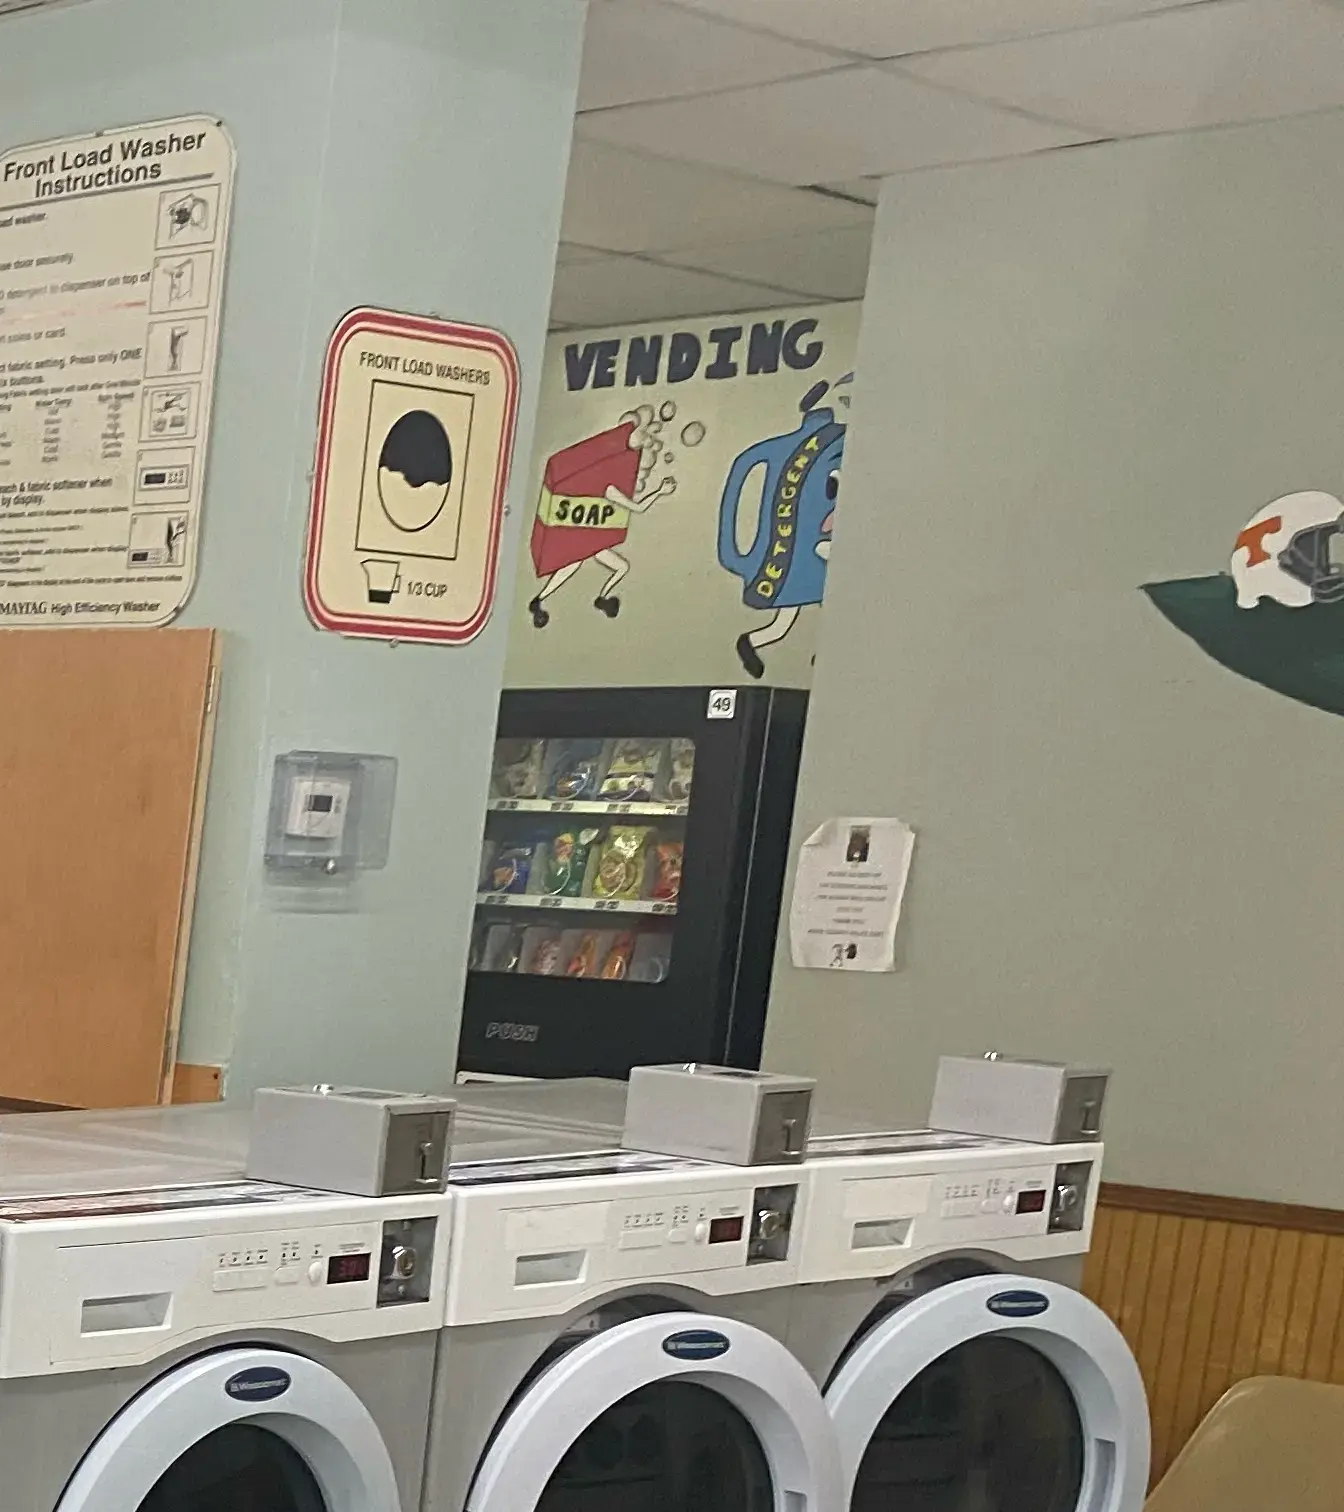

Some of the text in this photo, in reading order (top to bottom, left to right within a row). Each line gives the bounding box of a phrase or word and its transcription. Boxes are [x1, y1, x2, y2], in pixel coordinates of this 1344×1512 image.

[3, 131, 207, 183] Front Load Washer
[35, 160, 162, 199] Instructions
[122, 274, 139, 285] top
[140, 271, 151, 283] of
[359, 351, 492, 386] FRONT LOAD WASHERS
[564, 318, 824, 392] VENDING
[555, 499, 615, 526] SOAP
[756, 436, 820, 598] DETERGENT
[407, 580, 448, 598] 1/3 CUP
[0, 601, 161, 616] MAYTAG High Efficiency Washer
[711, 696, 732, 713] 49
